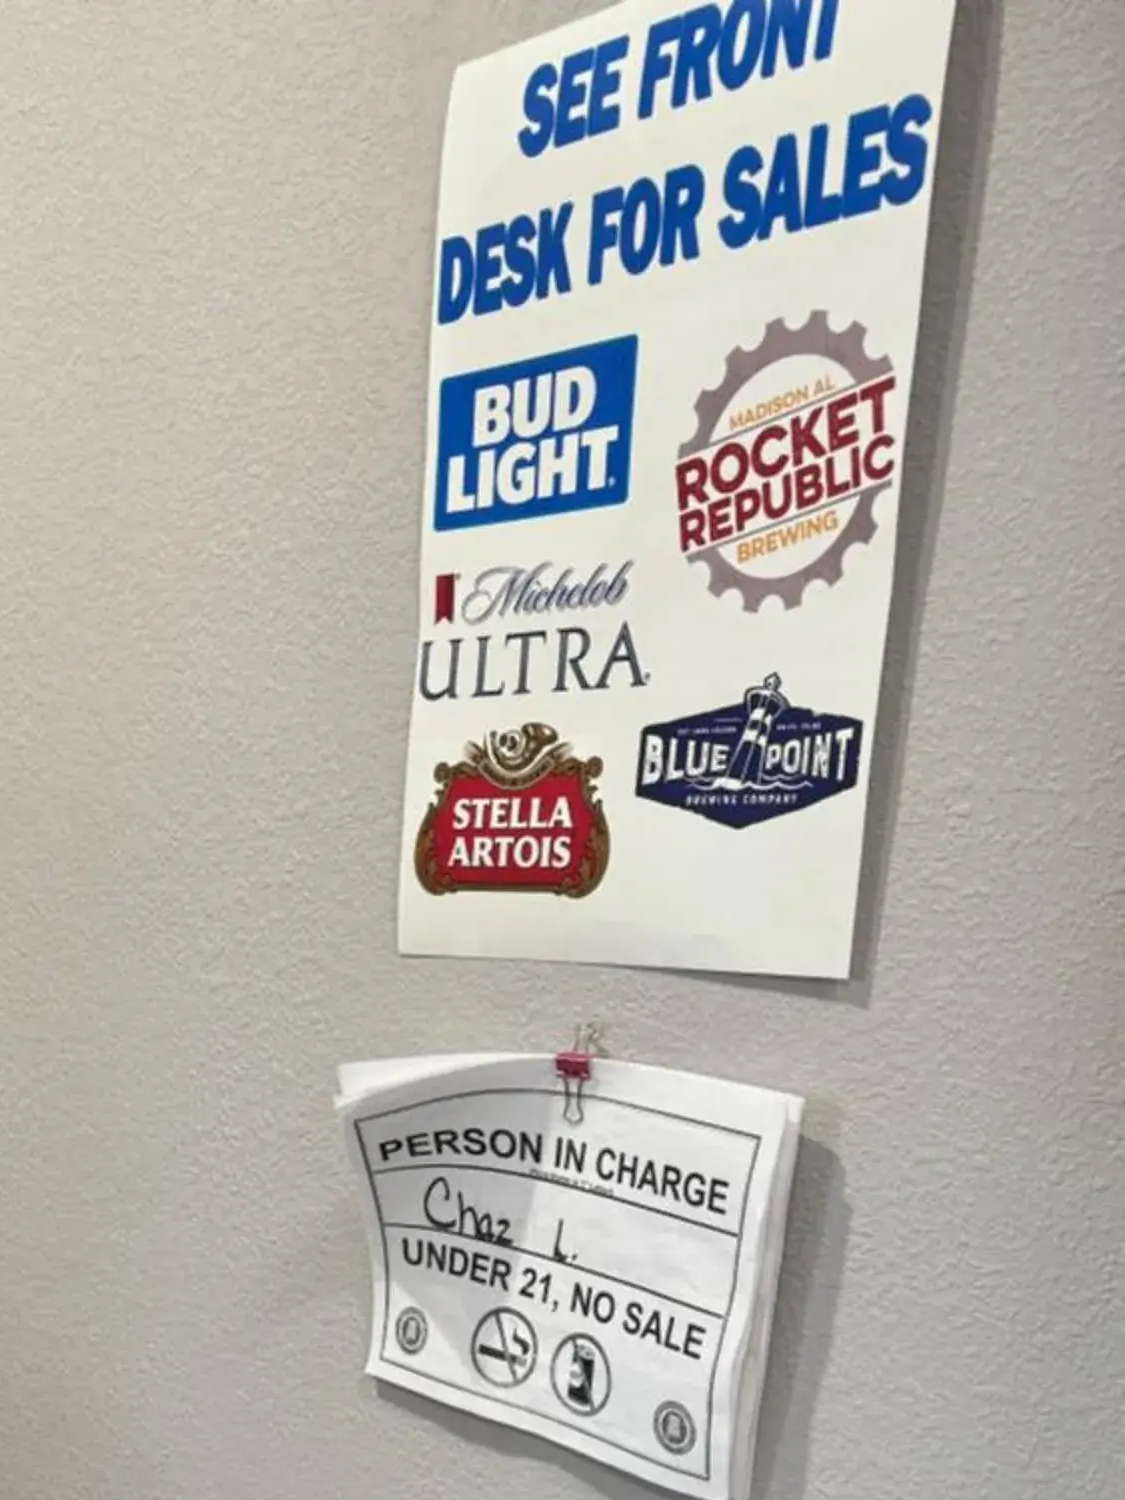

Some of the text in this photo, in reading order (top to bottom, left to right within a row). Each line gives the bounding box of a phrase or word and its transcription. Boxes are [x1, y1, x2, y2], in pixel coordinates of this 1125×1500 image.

[517, 34, 630, 158] SEE
[437, 93, 933, 325] DESK FOR SALES
[472, 365, 597, 449] BUD
[675, 375, 896, 511] ROCKET
[729, 374, 836, 430] MADISON AL
[446, 425, 620, 514] LIGHT
[679, 434, 895, 552] REPUBLIC
[736, 510, 838, 564] BREWING
[461, 560, 635, 626] Michelob
[419, 620, 647, 701] ULTRA
[641, 727, 855, 786] BLUE POINT
[452, 796, 573, 830] STELLA
[686, 793, 798, 806] BREWING COMPANY
[447, 835, 572, 869] ARTOIS
[379, 1128, 543, 1164] PERSON
[554, 1136, 587, 1175] IN
[596, 1147, 730, 1215] CHARGE
[402, 1238, 707, 1360] UNDER 21, NO SALE
